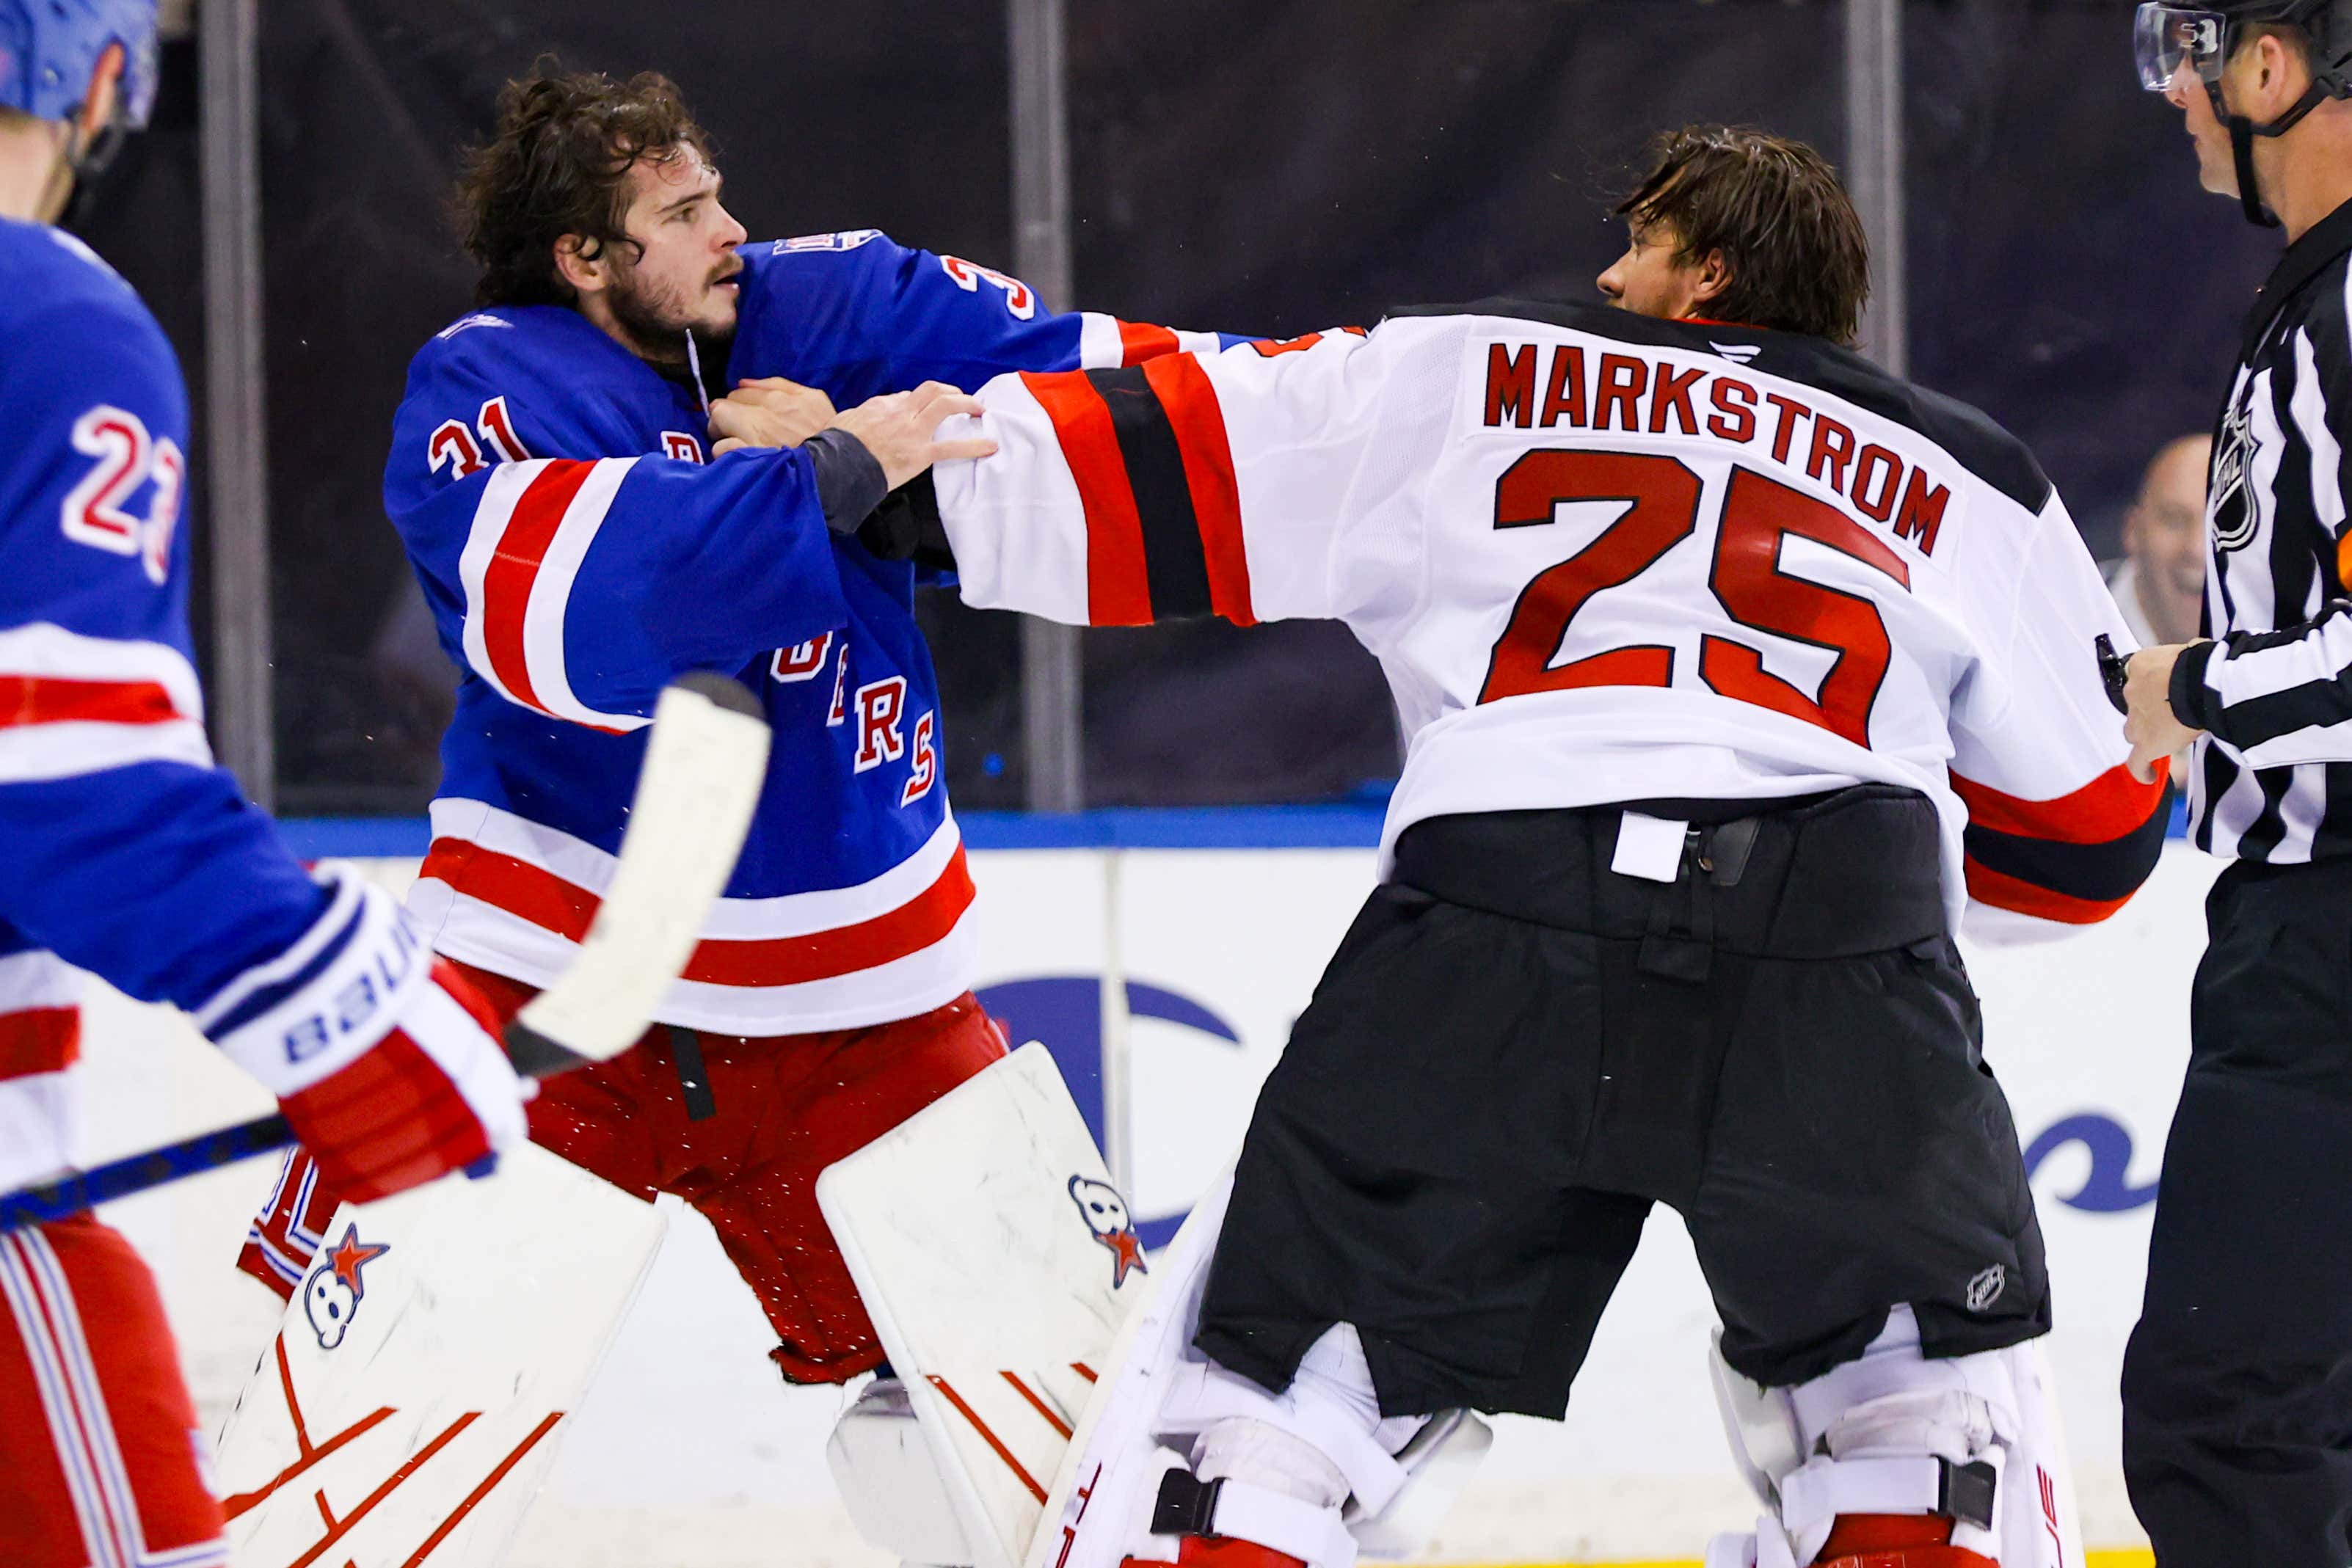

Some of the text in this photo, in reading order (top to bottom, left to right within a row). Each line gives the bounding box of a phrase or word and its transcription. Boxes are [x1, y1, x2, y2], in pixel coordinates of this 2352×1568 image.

[427, 395, 533, 482] 31
[1482, 342, 1952, 558] MARKSTROM
[1475, 447, 1912, 751] 25
